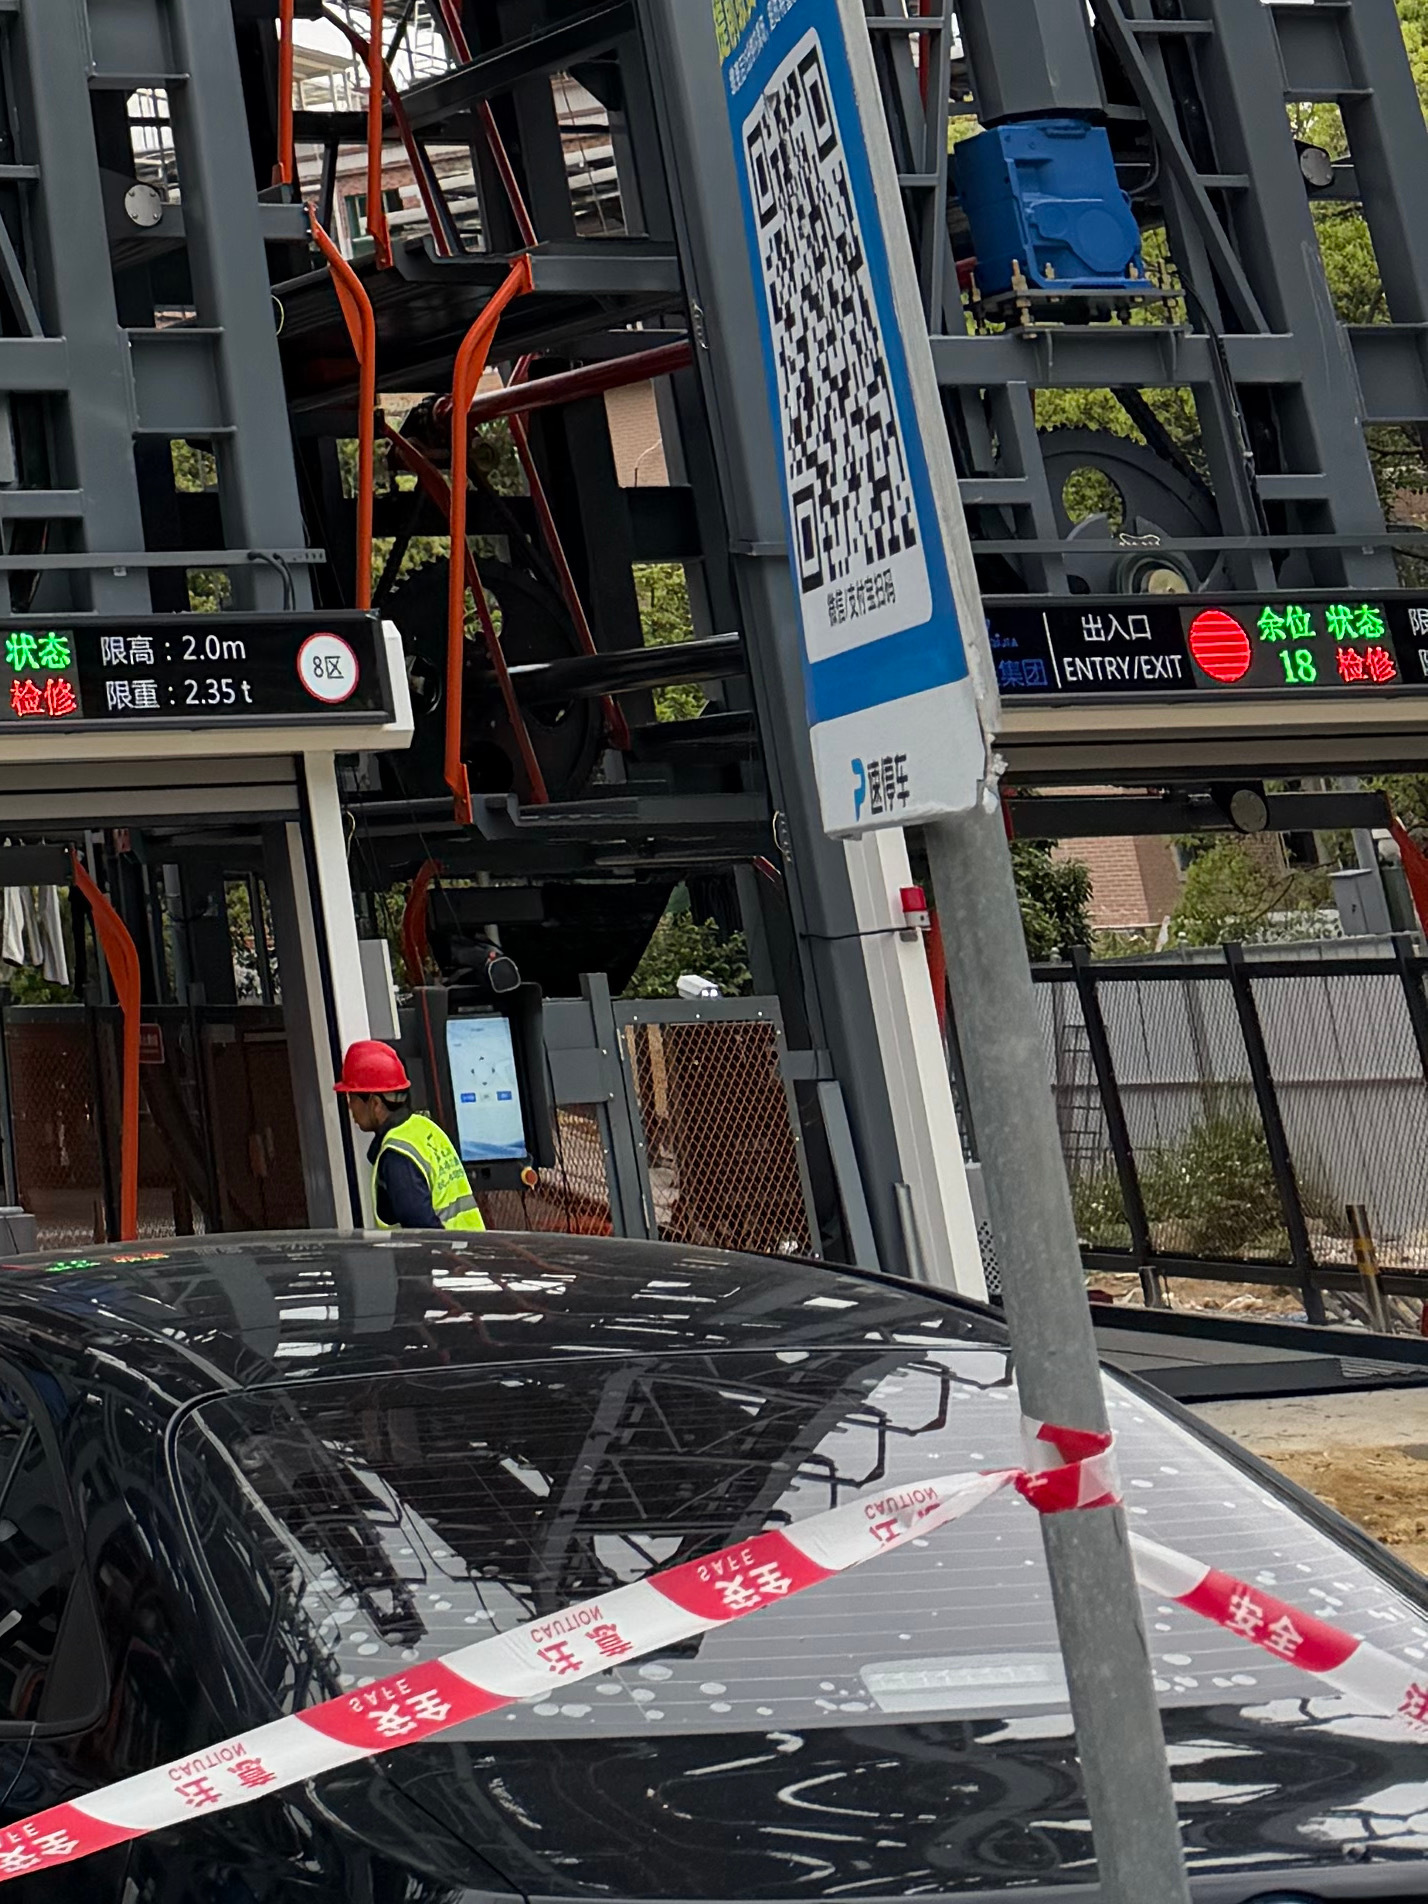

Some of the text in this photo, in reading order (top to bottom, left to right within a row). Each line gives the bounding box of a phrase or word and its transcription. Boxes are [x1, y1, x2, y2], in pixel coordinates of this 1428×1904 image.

[1083, 614, 1152, 642] 出入口
[1256, 604, 1385, 642] 余位 状态
[6, 631, 71, 671] 状态
[312, 654, 345, 681] 8区
[1062, 653, 1183, 683] ENTRY/EXIT
[1278, 649, 1318, 684] 18
[1336, 646, 1397, 683] 检修
[10, 678, 77, 717] 检修
[867, 754, 910, 815] 速停车
